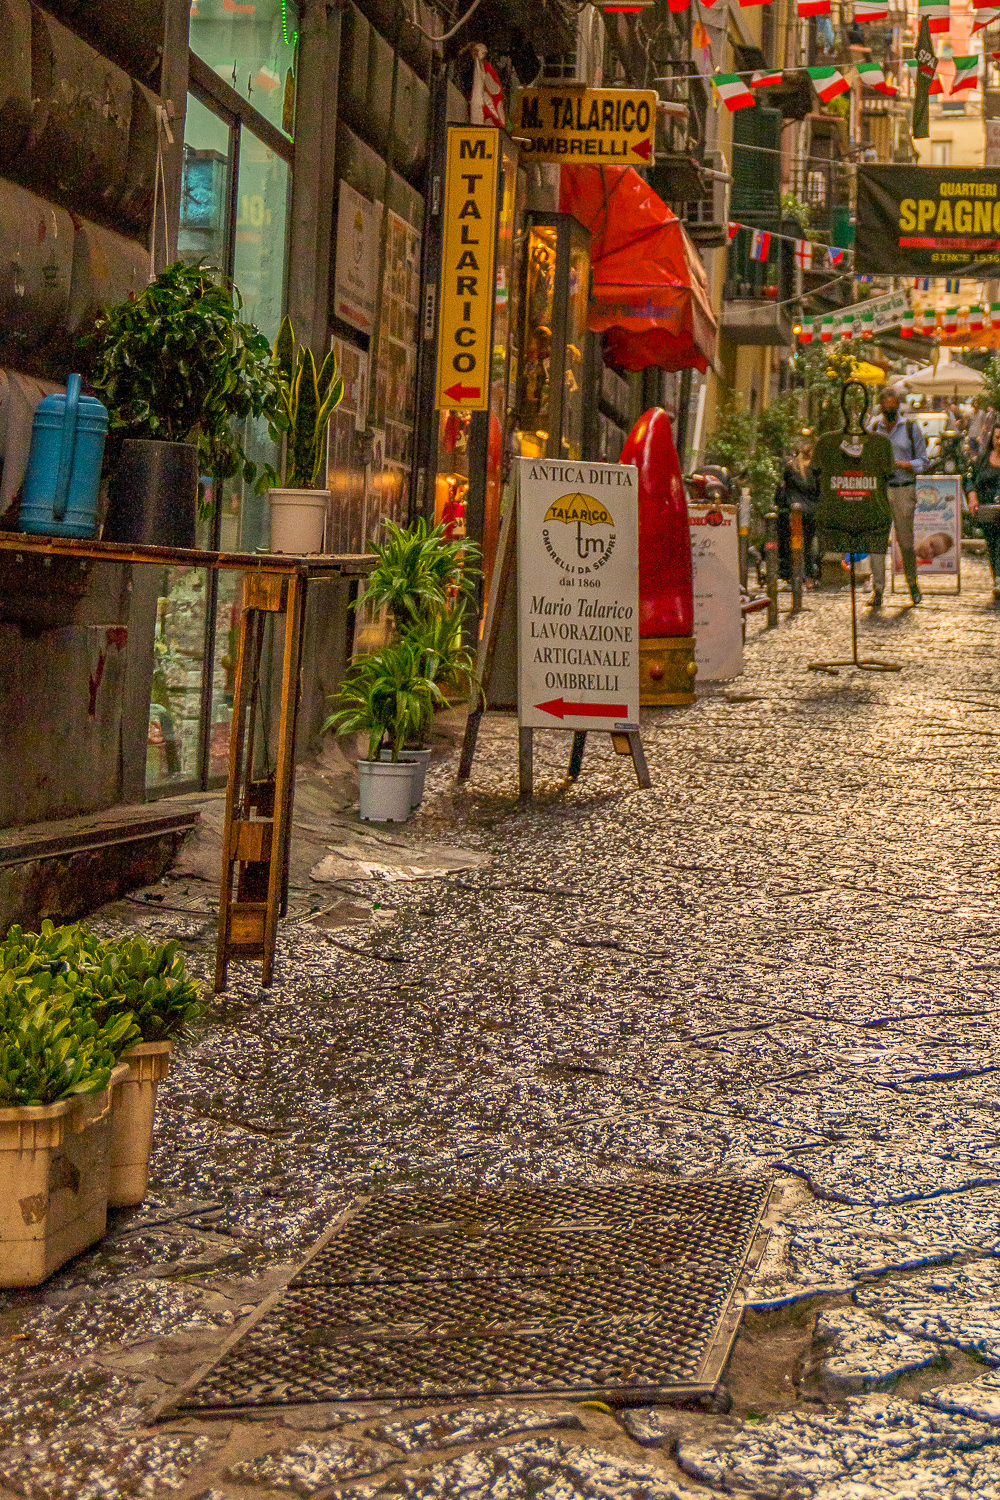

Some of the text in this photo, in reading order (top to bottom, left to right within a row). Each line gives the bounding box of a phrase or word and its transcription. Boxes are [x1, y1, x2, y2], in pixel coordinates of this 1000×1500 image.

[521, 97, 650, 133] M. TALARICO
[459, 139, 492, 159] M.
[520, 137, 628, 156] OMBRELLI
[940, 182, 998, 198] QUARTIERI
[931, 253, 971, 263] SINCE
[452, 173, 483, 374] TALARICO
[528, 465, 633, 487] ANTICA DITTA
[830, 476, 877, 490] SPAGNOLI
[551, 507, 608, 521] TALARICO
[542, 529, 616, 575] OMBRELLI DA SEMPRE
[559, 577, 601, 588] dal 1860
[529, 595, 633, 620] Mario Talarico
[530, 622, 633, 643] LAVORAZIONE
[533, 647, 631, 668] ARTIGIANALE
[545, 672, 620, 692] OMBRELLI
